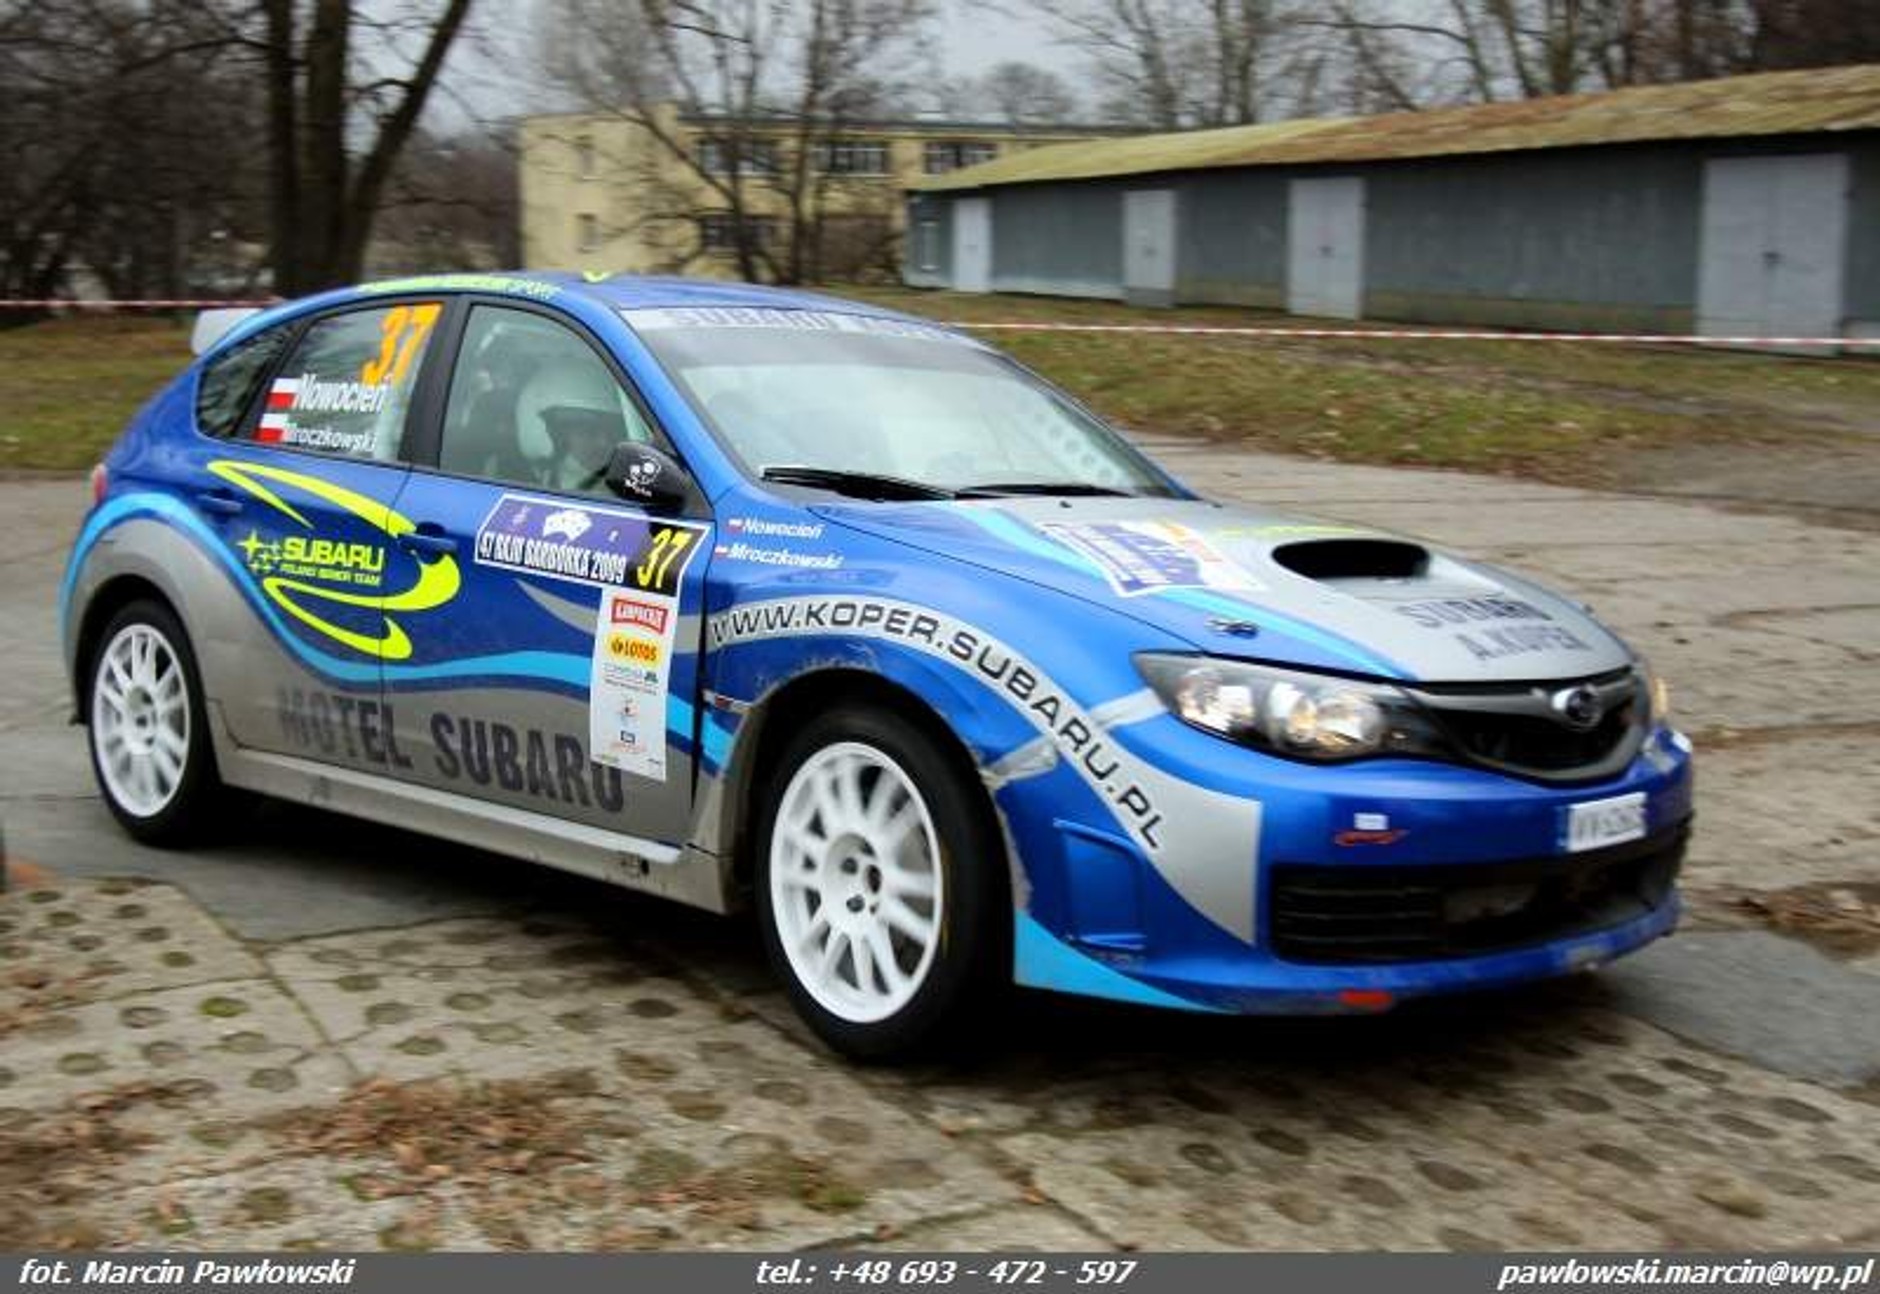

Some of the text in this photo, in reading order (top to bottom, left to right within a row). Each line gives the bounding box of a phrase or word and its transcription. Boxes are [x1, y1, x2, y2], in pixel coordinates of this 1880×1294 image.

[361, 301, 443, 387] 37
[283, 537, 384, 571] SUBARU
[591, 553, 627, 583] 2009
[636, 529, 692, 588] 37
[625, 639, 657, 661] LOTOS
[430, 711, 625, 812] SUBARU
